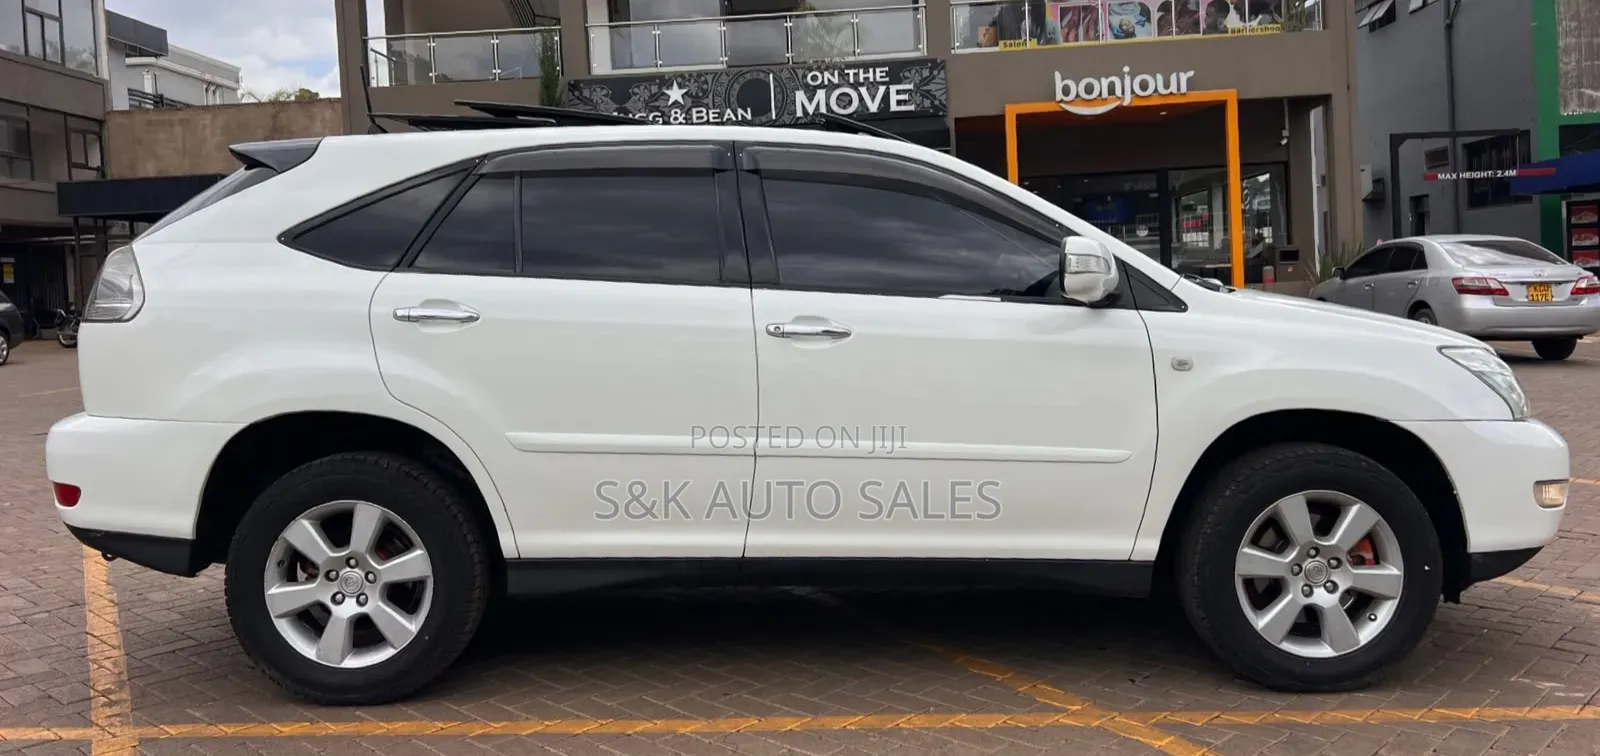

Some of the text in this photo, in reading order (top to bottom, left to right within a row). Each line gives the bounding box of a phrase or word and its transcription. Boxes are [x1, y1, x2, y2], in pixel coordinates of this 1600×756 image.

[807, 66, 890, 86] ON THE
[1054, 65, 1195, 106] bonjour
[795, 83, 915, 117] MOVE
[669, 108, 686, 124] &
[692, 107, 752, 123] BEAN
[1437, 169, 1517, 180] MAX HEIGHT: 2.4M
